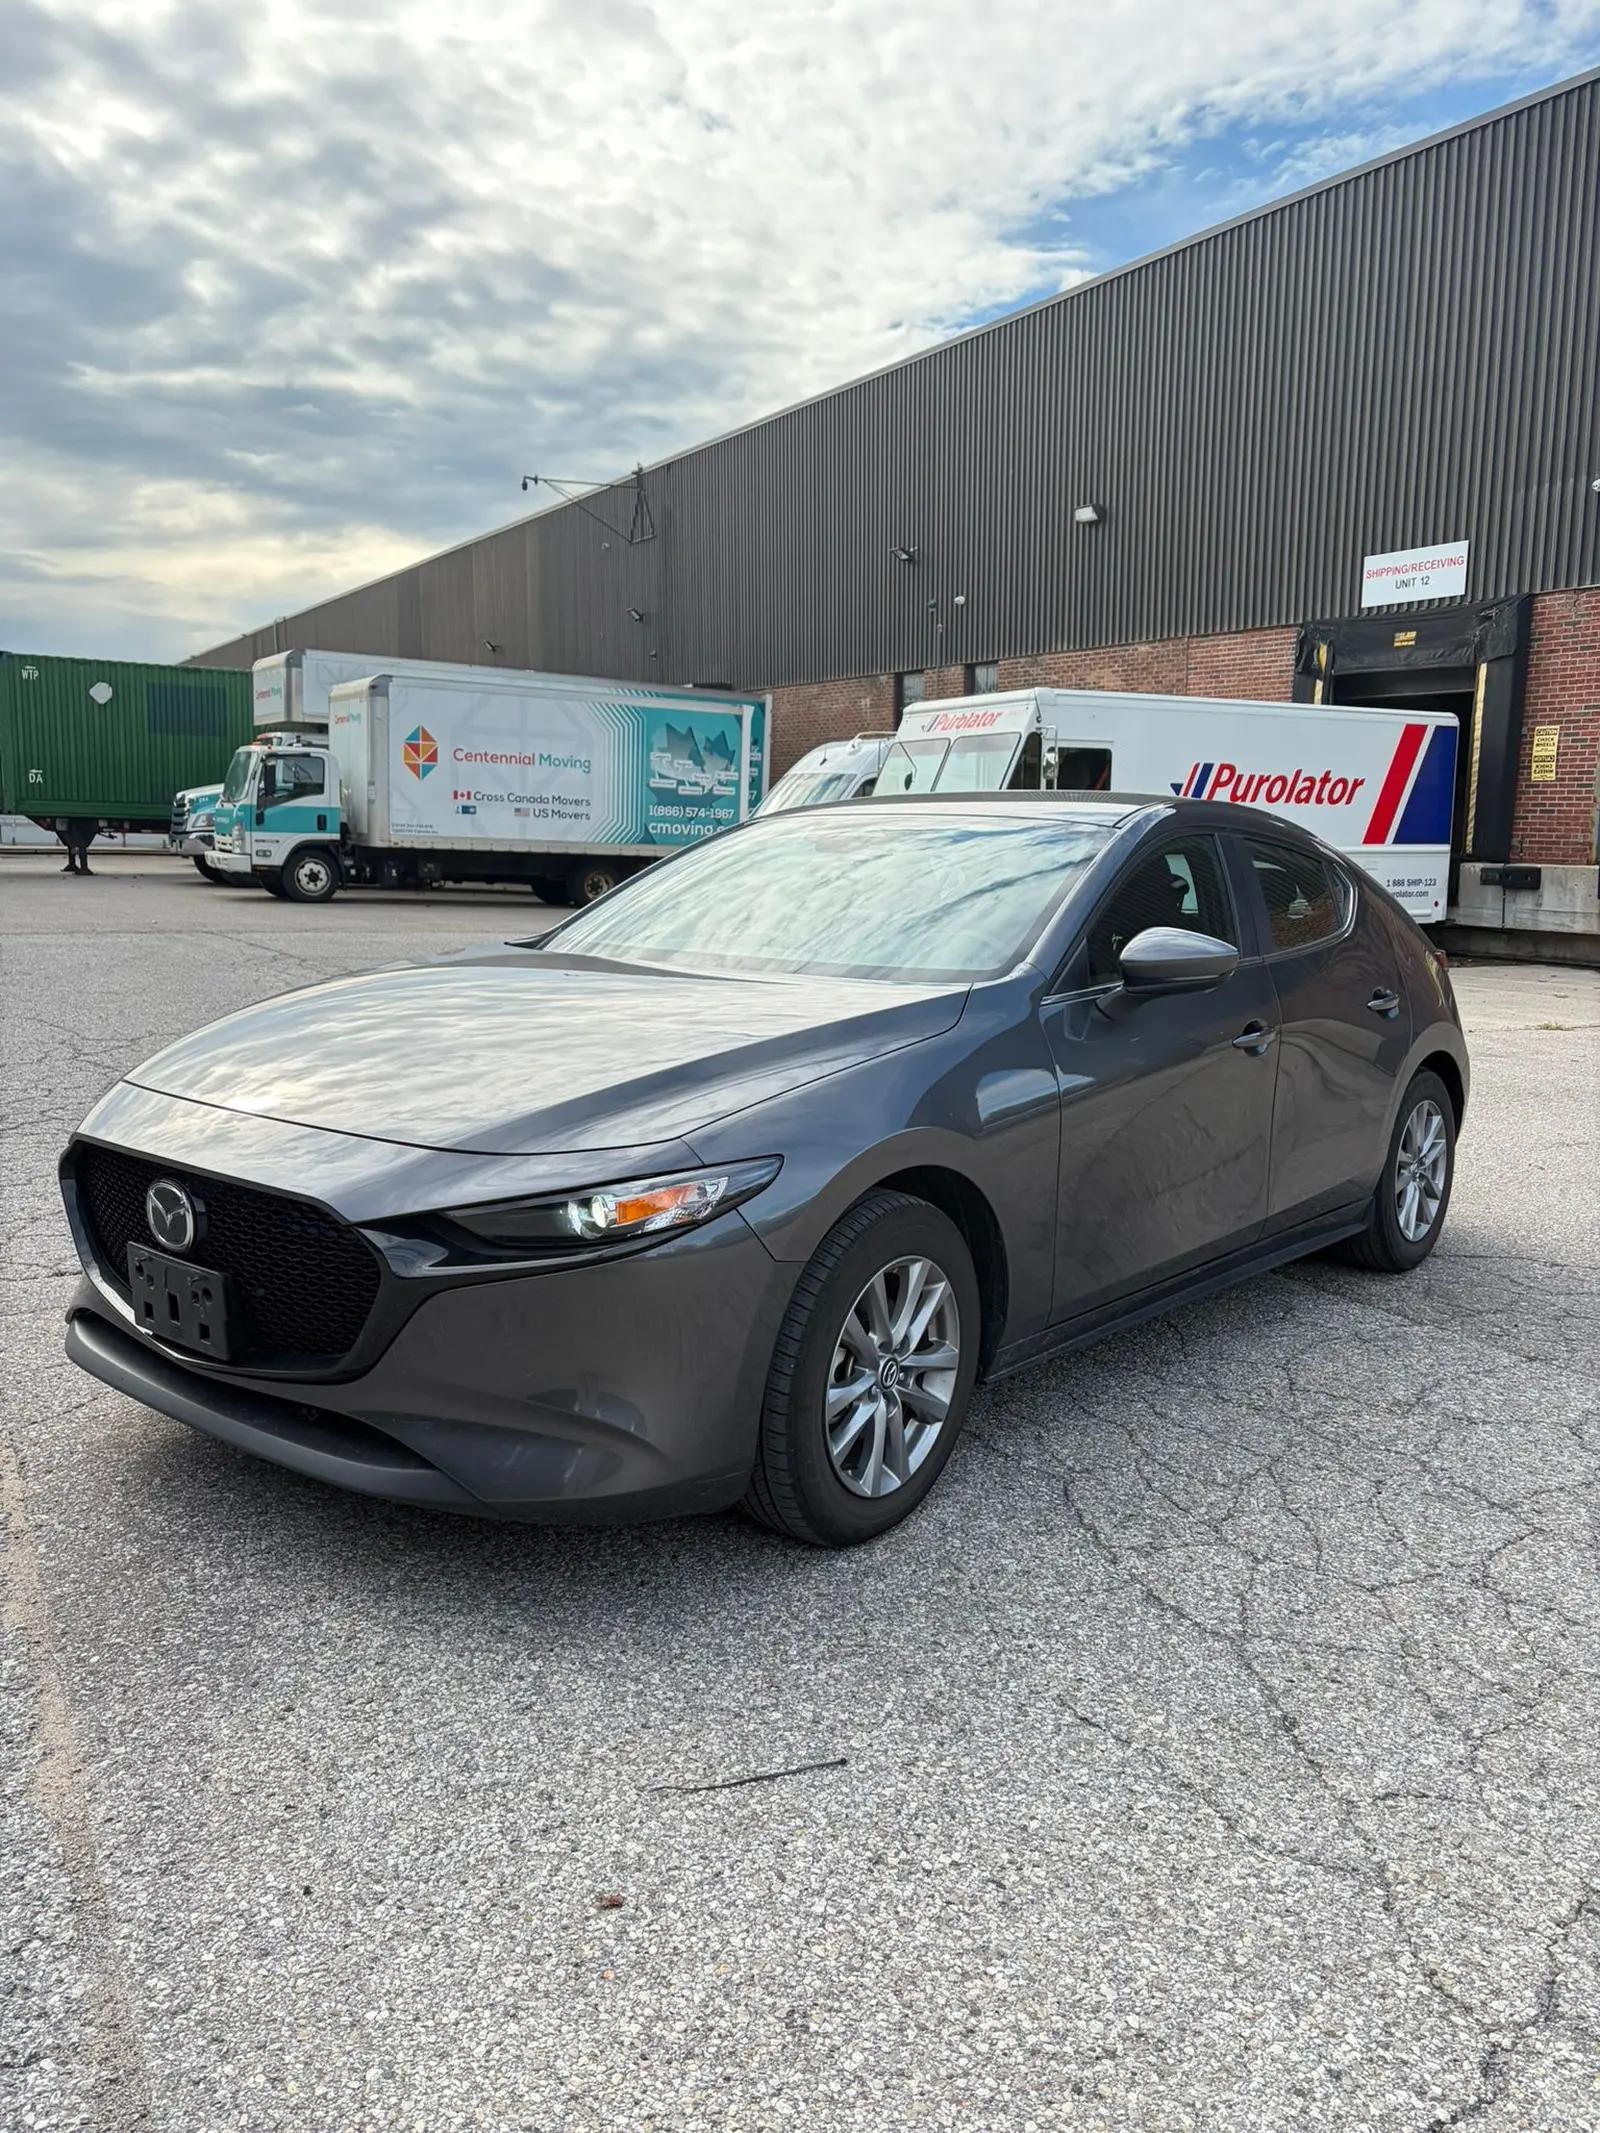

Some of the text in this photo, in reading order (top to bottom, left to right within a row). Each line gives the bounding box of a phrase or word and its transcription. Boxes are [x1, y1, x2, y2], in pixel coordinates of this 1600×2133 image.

[1366, 556, 1465, 579] SHIPPING/RECEIVING
[1395, 575, 1430, 589] UNIT 12
[21, 669, 39, 680] WTP
[453, 748, 592, 774] Centennial Moving
[28, 772, 44, 783] DA
[1207, 763, 1366, 805] Purolator
[473, 791, 591, 807] Cross Canada Movers
[532, 808, 591, 821] US Movers
[685, 806, 735, 819] 574-1967
